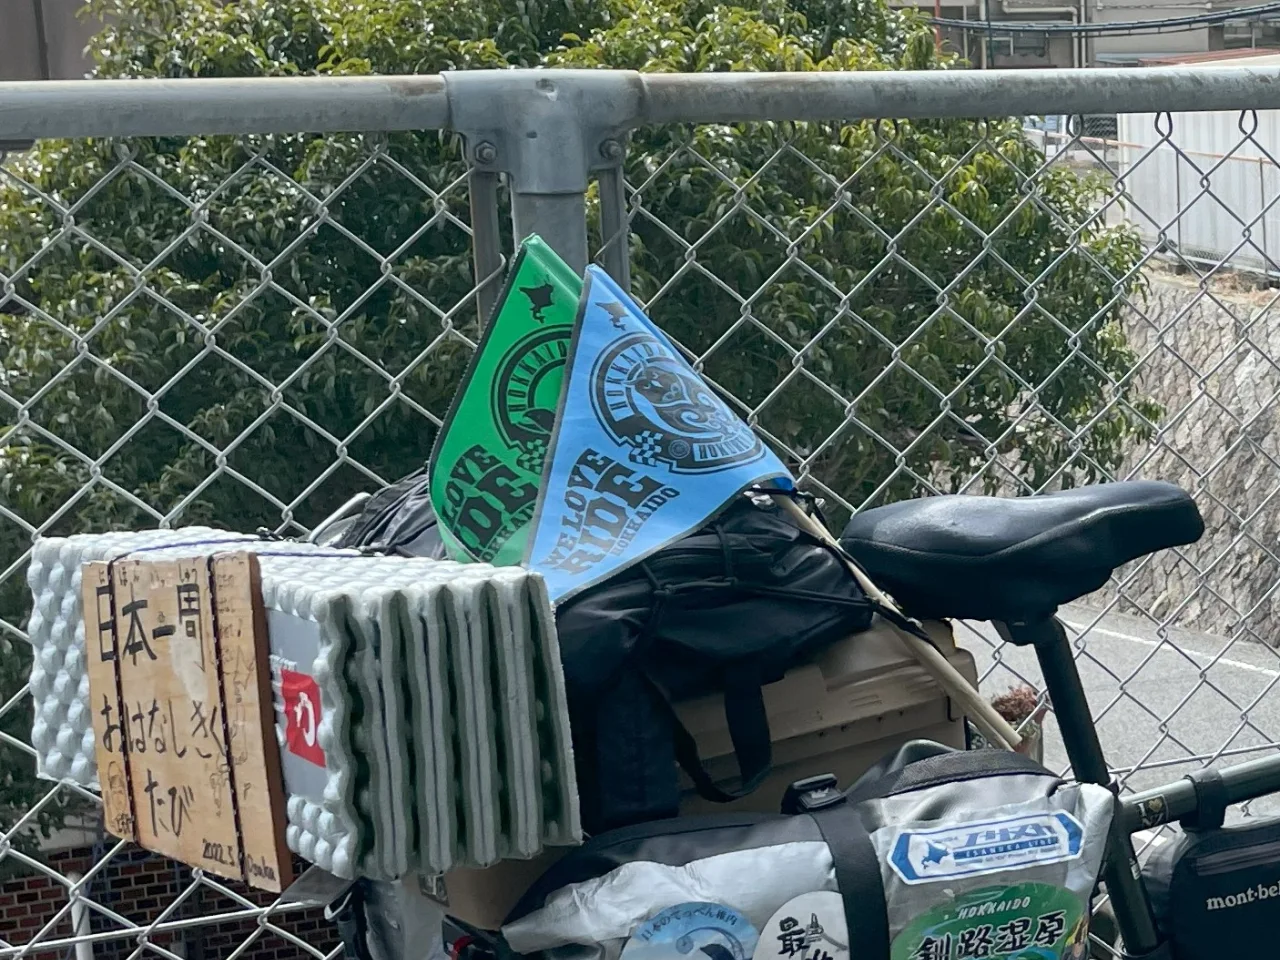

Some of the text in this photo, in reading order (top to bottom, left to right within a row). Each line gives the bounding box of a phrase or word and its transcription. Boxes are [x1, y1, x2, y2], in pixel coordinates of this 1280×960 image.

[550, 462, 666, 576] RIDE
[561, 448, 615, 533] LOVE
[96, 581, 206, 673] 日本一周
[144, 768, 195, 838] たび
[957, 896, 1031, 920] HOKKAIDO
